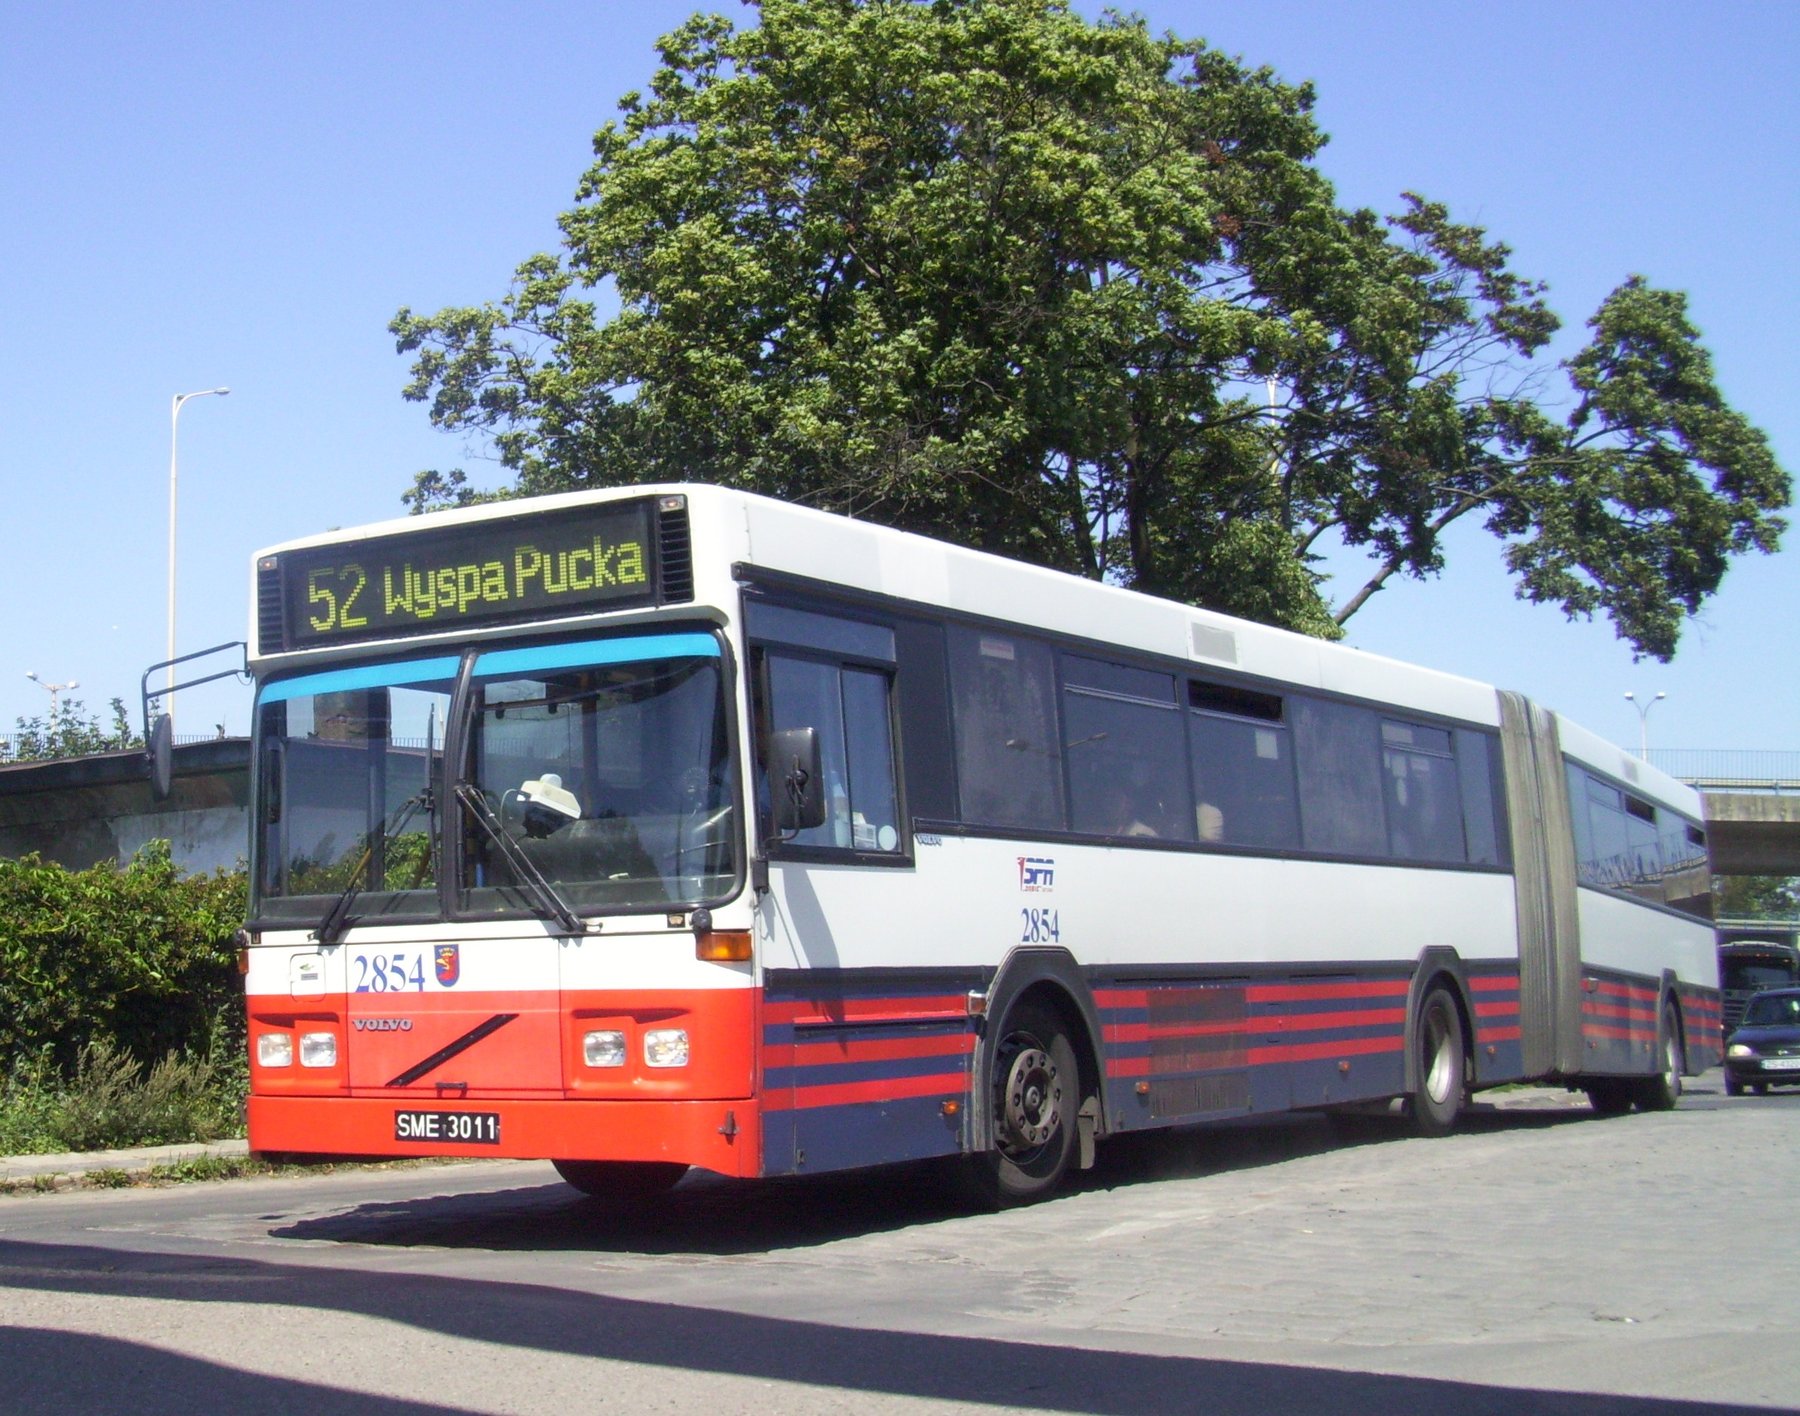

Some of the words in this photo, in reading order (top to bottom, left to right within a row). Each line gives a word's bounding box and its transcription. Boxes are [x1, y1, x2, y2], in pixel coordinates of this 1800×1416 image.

[308, 564, 367, 632] 52
[384, 561, 508, 619] Wyspa
[515, 537, 646, 598] Pucka
[1021, 908, 1059, 943] 2854
[353, 953, 426, 993] 2854
[352, 1018, 414, 1032] VOLVO
[397, 1113, 440, 1138] SME
[447, 1115, 495, 1140] 3011
